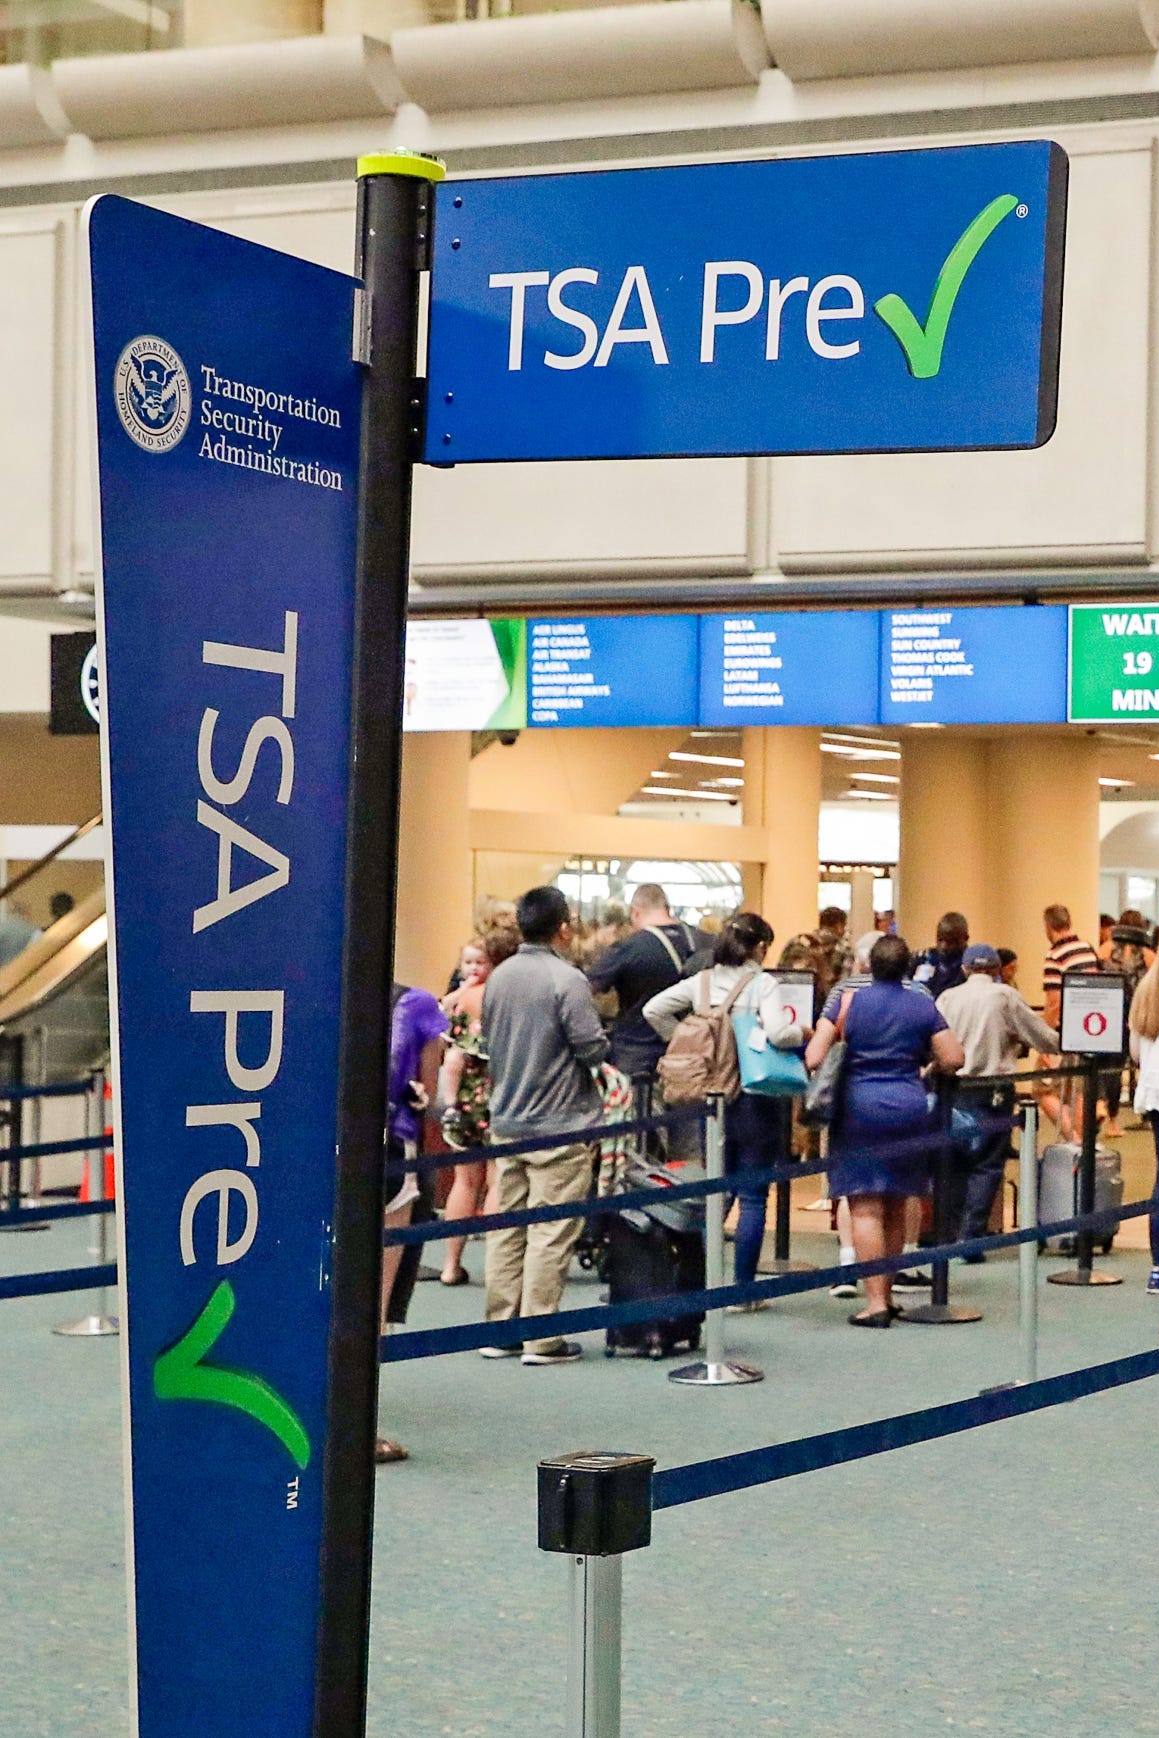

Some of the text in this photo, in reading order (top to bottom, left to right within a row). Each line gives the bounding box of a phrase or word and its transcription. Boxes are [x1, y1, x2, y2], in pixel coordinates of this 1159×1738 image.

[489, 260, 865, 371] TSA Pre
[131, 341, 182, 376] DEPARTMENT
[179, 378, 189, 395] OF
[201, 364, 342, 429] Transportation
[118, 392, 188, 447] HOMELAND SECURITY
[201, 399, 283, 451] Security
[199, 432, 343, 491] Administration
[1122, 651, 1153, 675] 19
[179, 611, 299, 1266] TSA Pre
